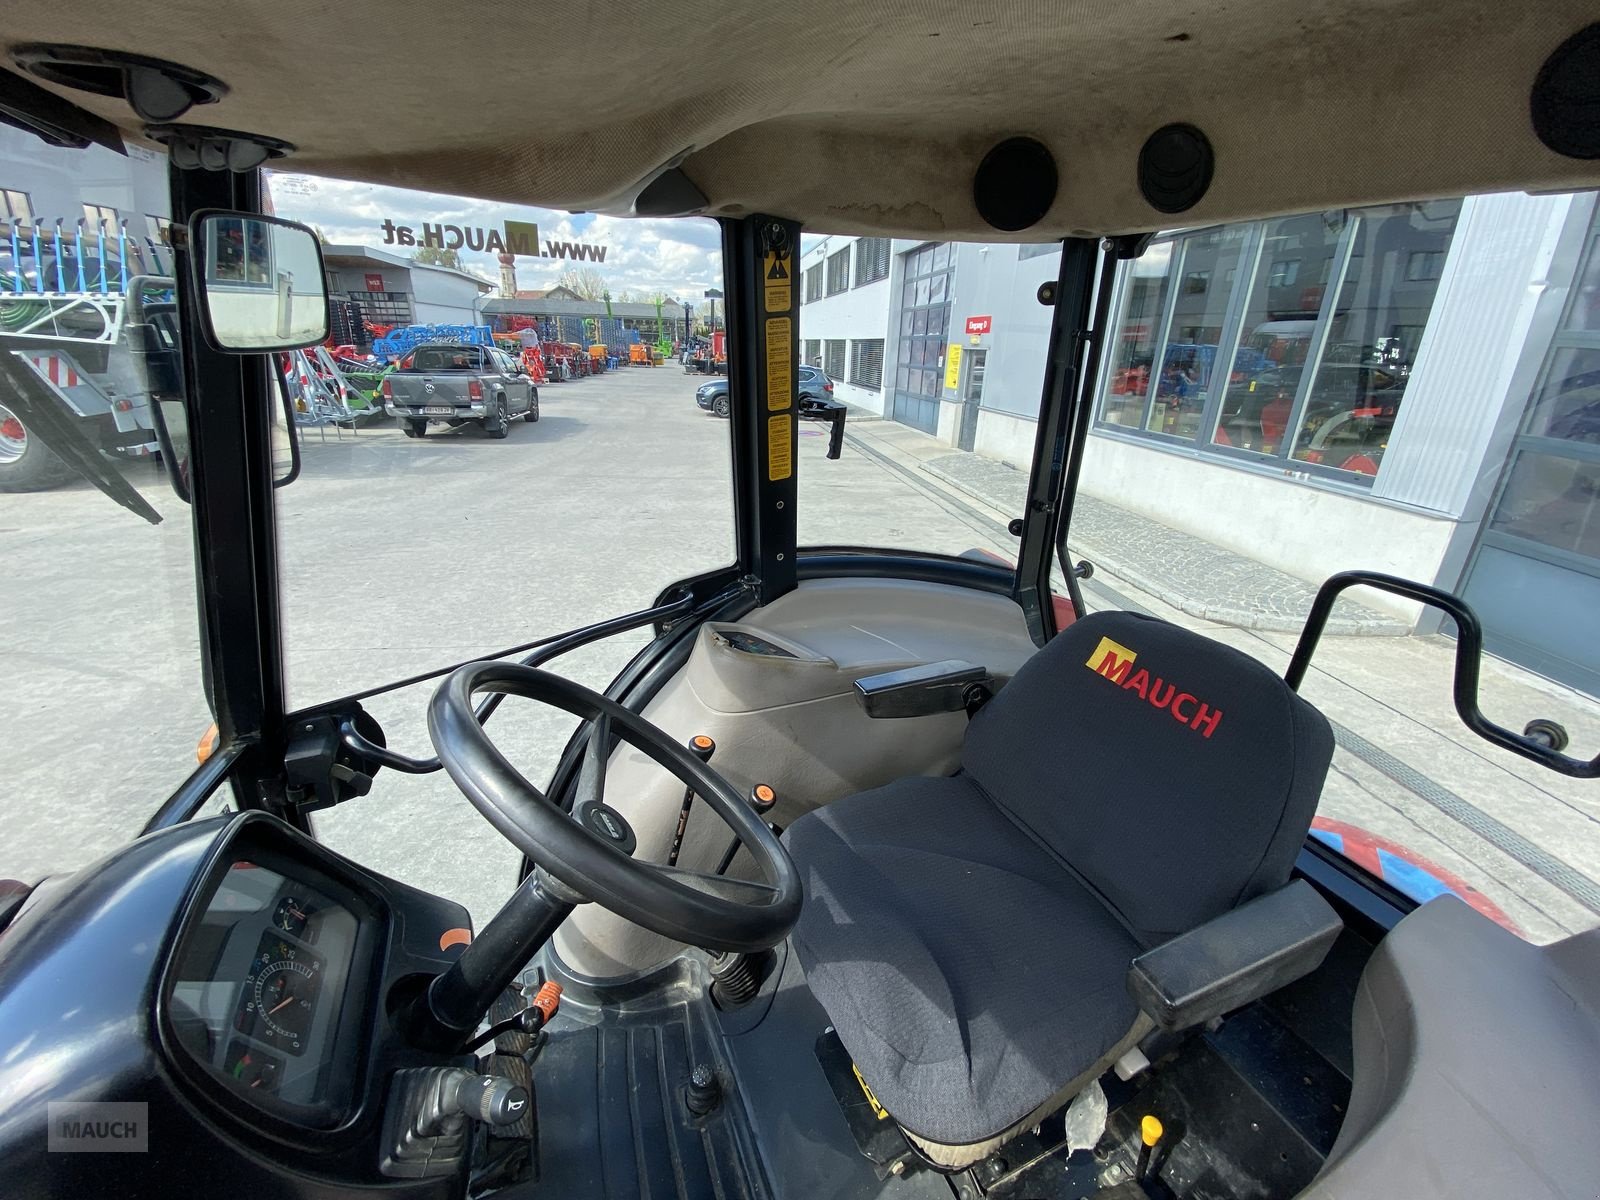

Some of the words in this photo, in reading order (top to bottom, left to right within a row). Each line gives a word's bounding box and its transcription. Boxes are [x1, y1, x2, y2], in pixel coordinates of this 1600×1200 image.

[1095, 650, 1224, 739] MAUCH
[261, 953, 270, 964] 20
[246, 975, 255, 984] 15
[246, 1003, 255, 1012] 10
